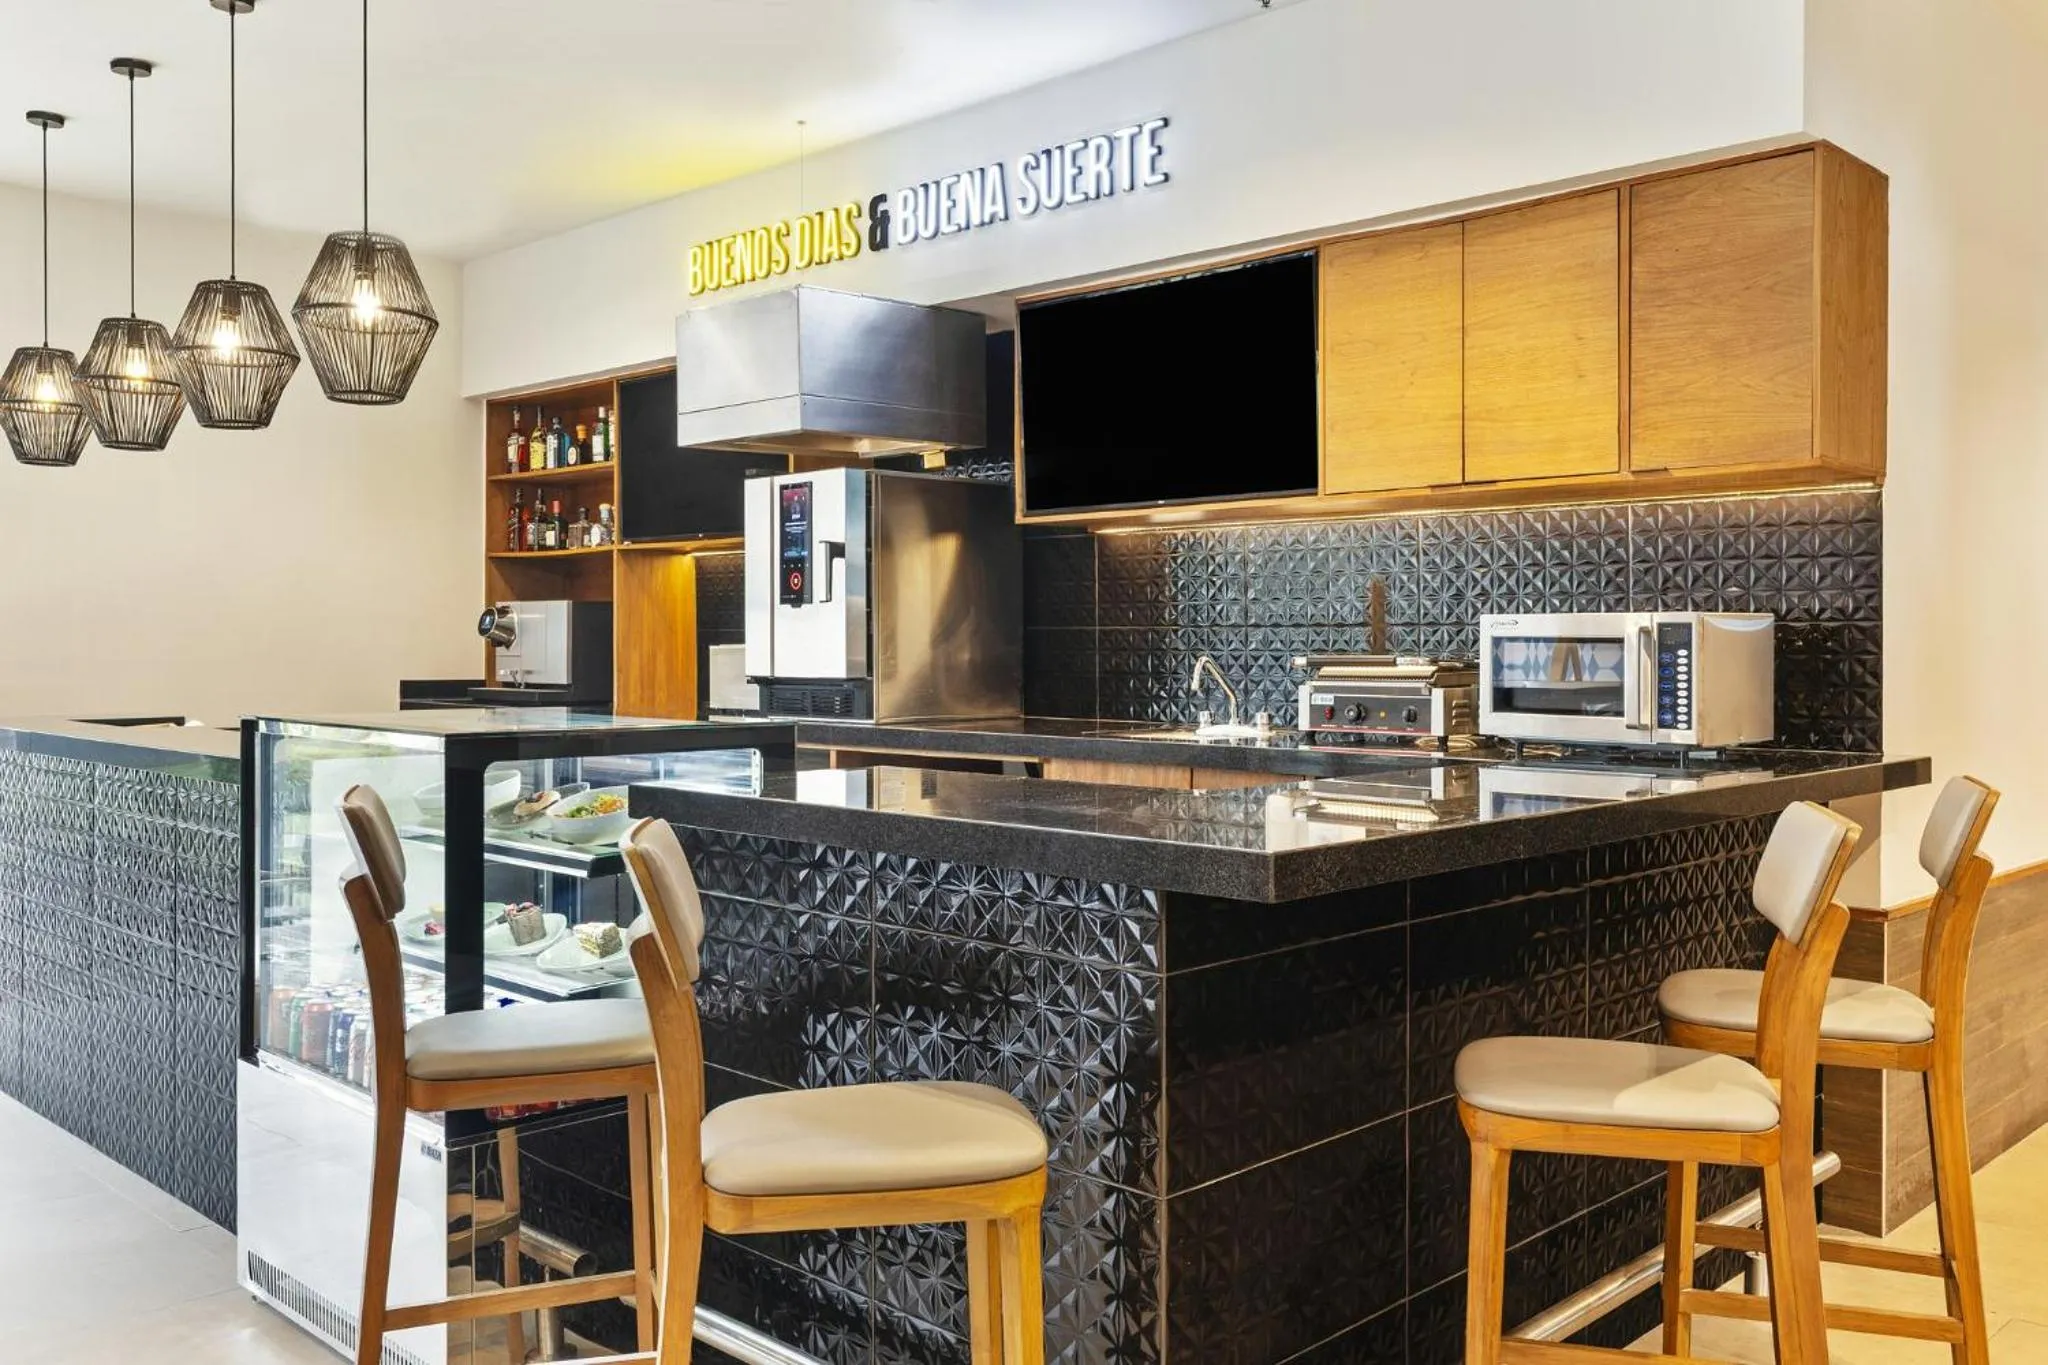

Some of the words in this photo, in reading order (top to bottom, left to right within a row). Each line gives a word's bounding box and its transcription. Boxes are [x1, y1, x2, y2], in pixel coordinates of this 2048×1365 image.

[689, 220, 790, 296] BUENOS
[795, 201, 862, 271] DIAS
[868, 193, 890, 251] &
[898, 161, 1009, 246] BUENA
[1016, 117, 1170, 217] SUERTE
